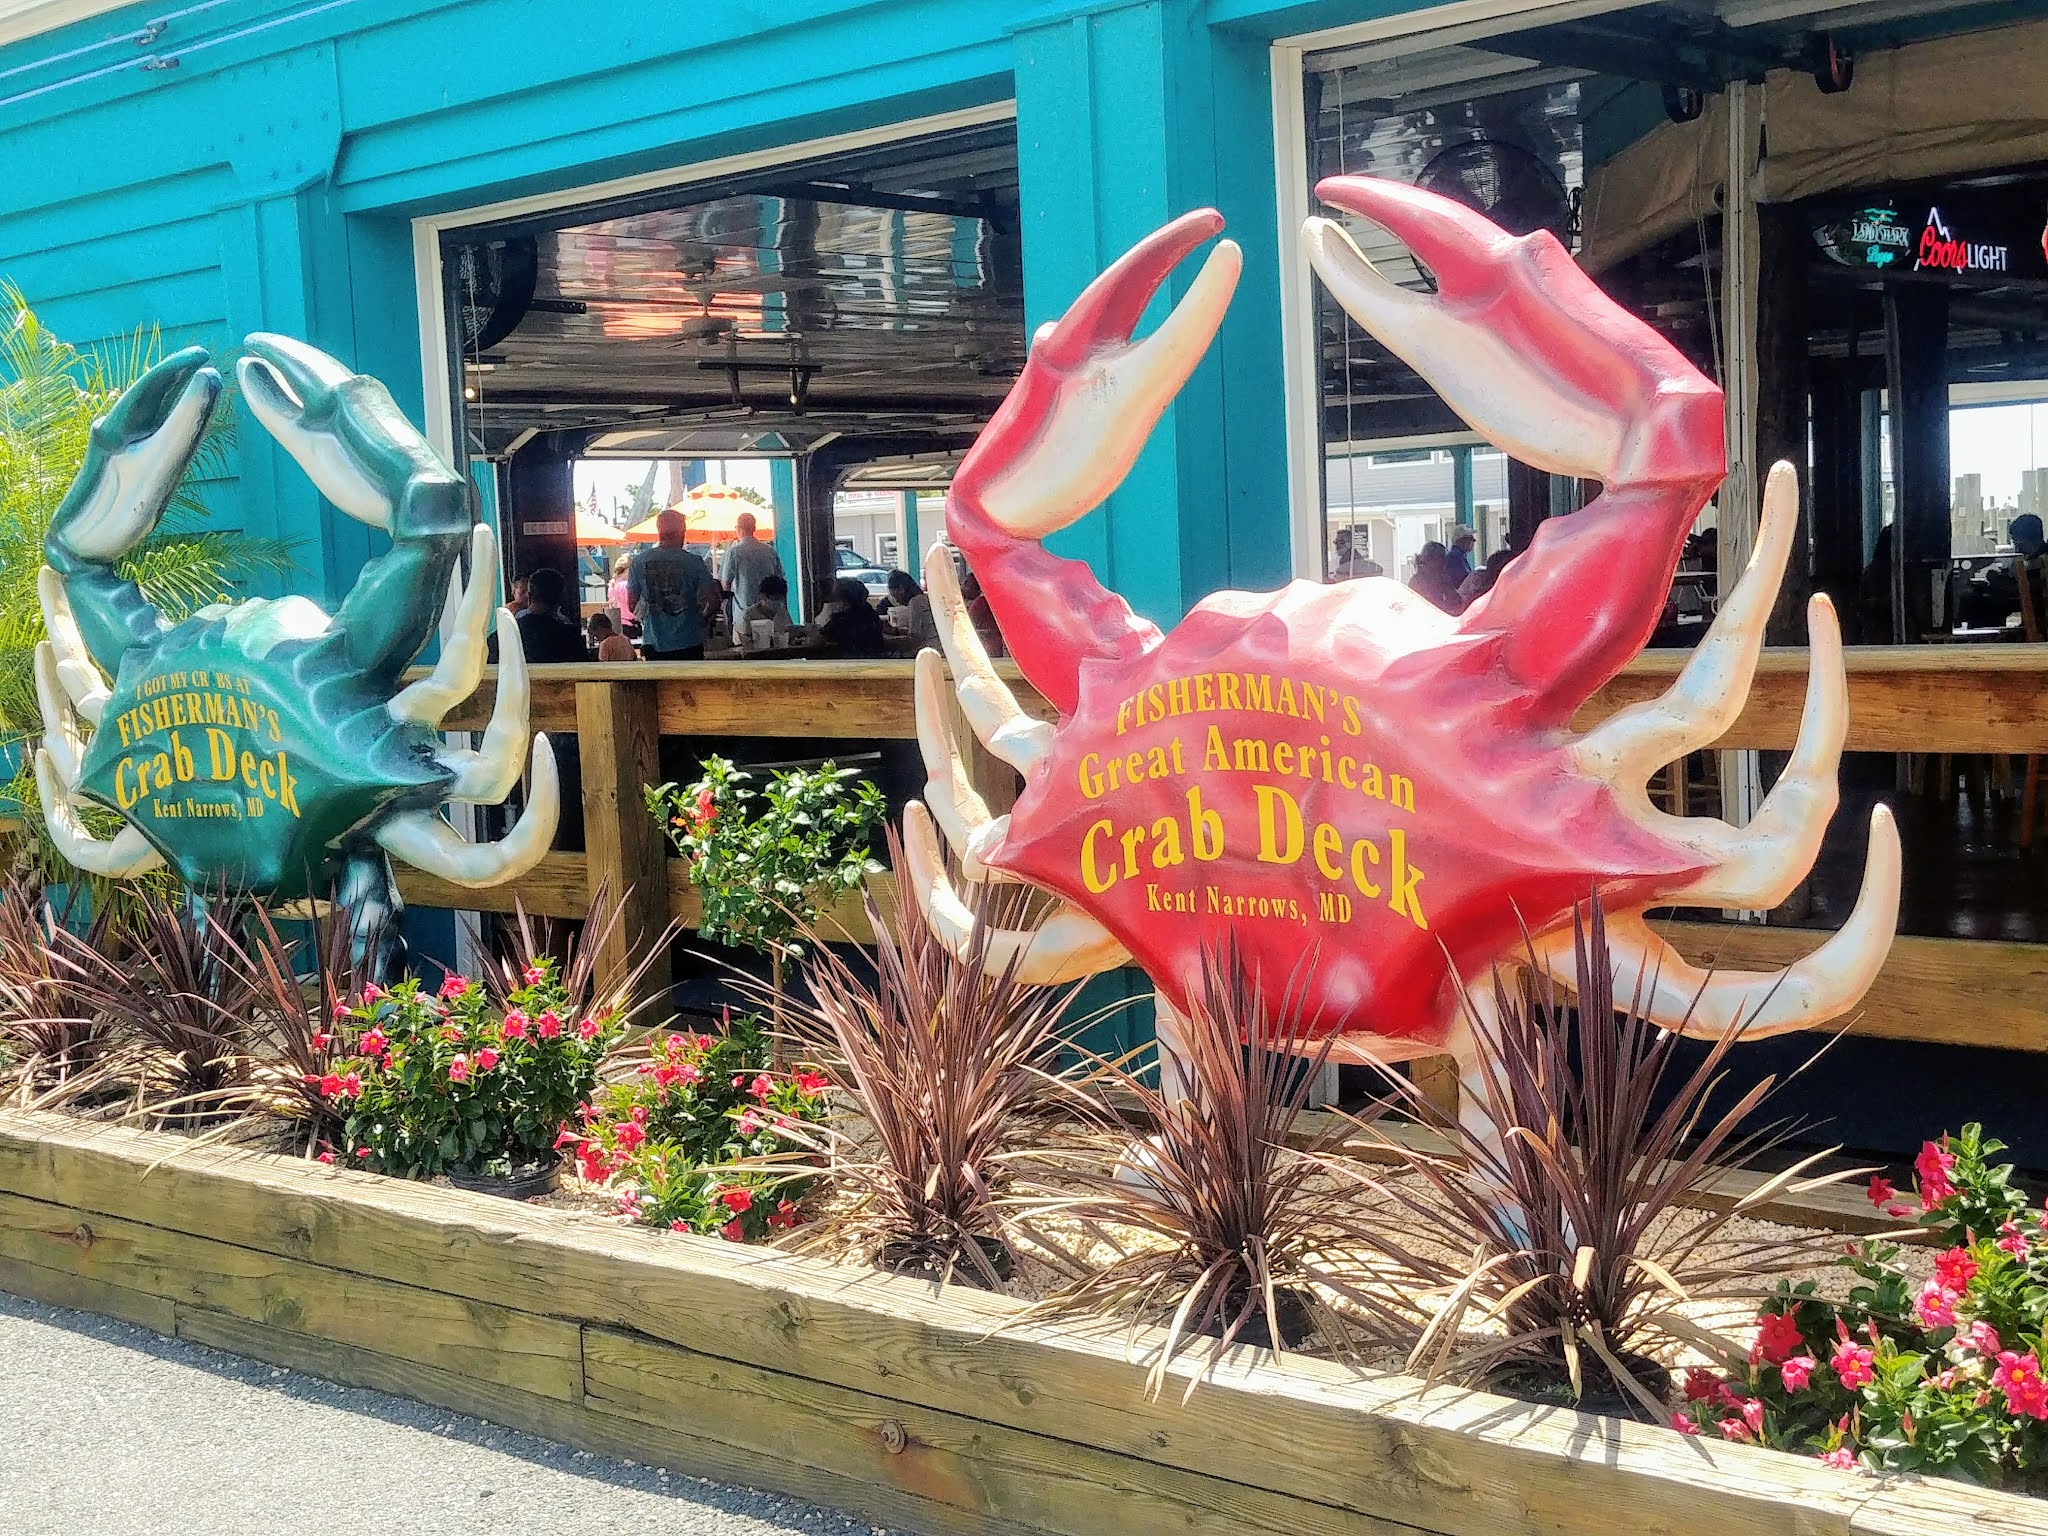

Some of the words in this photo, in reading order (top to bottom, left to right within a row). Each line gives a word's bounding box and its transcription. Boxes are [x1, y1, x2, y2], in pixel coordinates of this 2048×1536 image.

[1919, 225, 1967, 269] Coors
[1967, 243, 2007, 271] LIGHT
[144, 674, 168, 697] GOT
[170, 671, 188, 690] MY
[191, 670, 233, 690] CRBS
[236, 677, 251, 695] AT
[1116, 672, 1362, 736] FISHERMAN'S
[116, 692, 281, 748] FISHERMAN'S
[114, 730, 194, 810] Crab
[206, 728, 301, 819] Deck
[1079, 736, 1185, 800] Great
[1202, 724, 1416, 814] American
[153, 798, 181, 818] Kent
[187, 798, 242, 821] Narrows,
[247, 800, 264, 817] MD
[1081, 785, 1225, 894] Crab
[1253, 784, 1429, 931] Deck
[1146, 883, 1197, 913] Kent
[1206, 886, 1308, 925] Narrows,
[1319, 892, 1352, 924] MD
